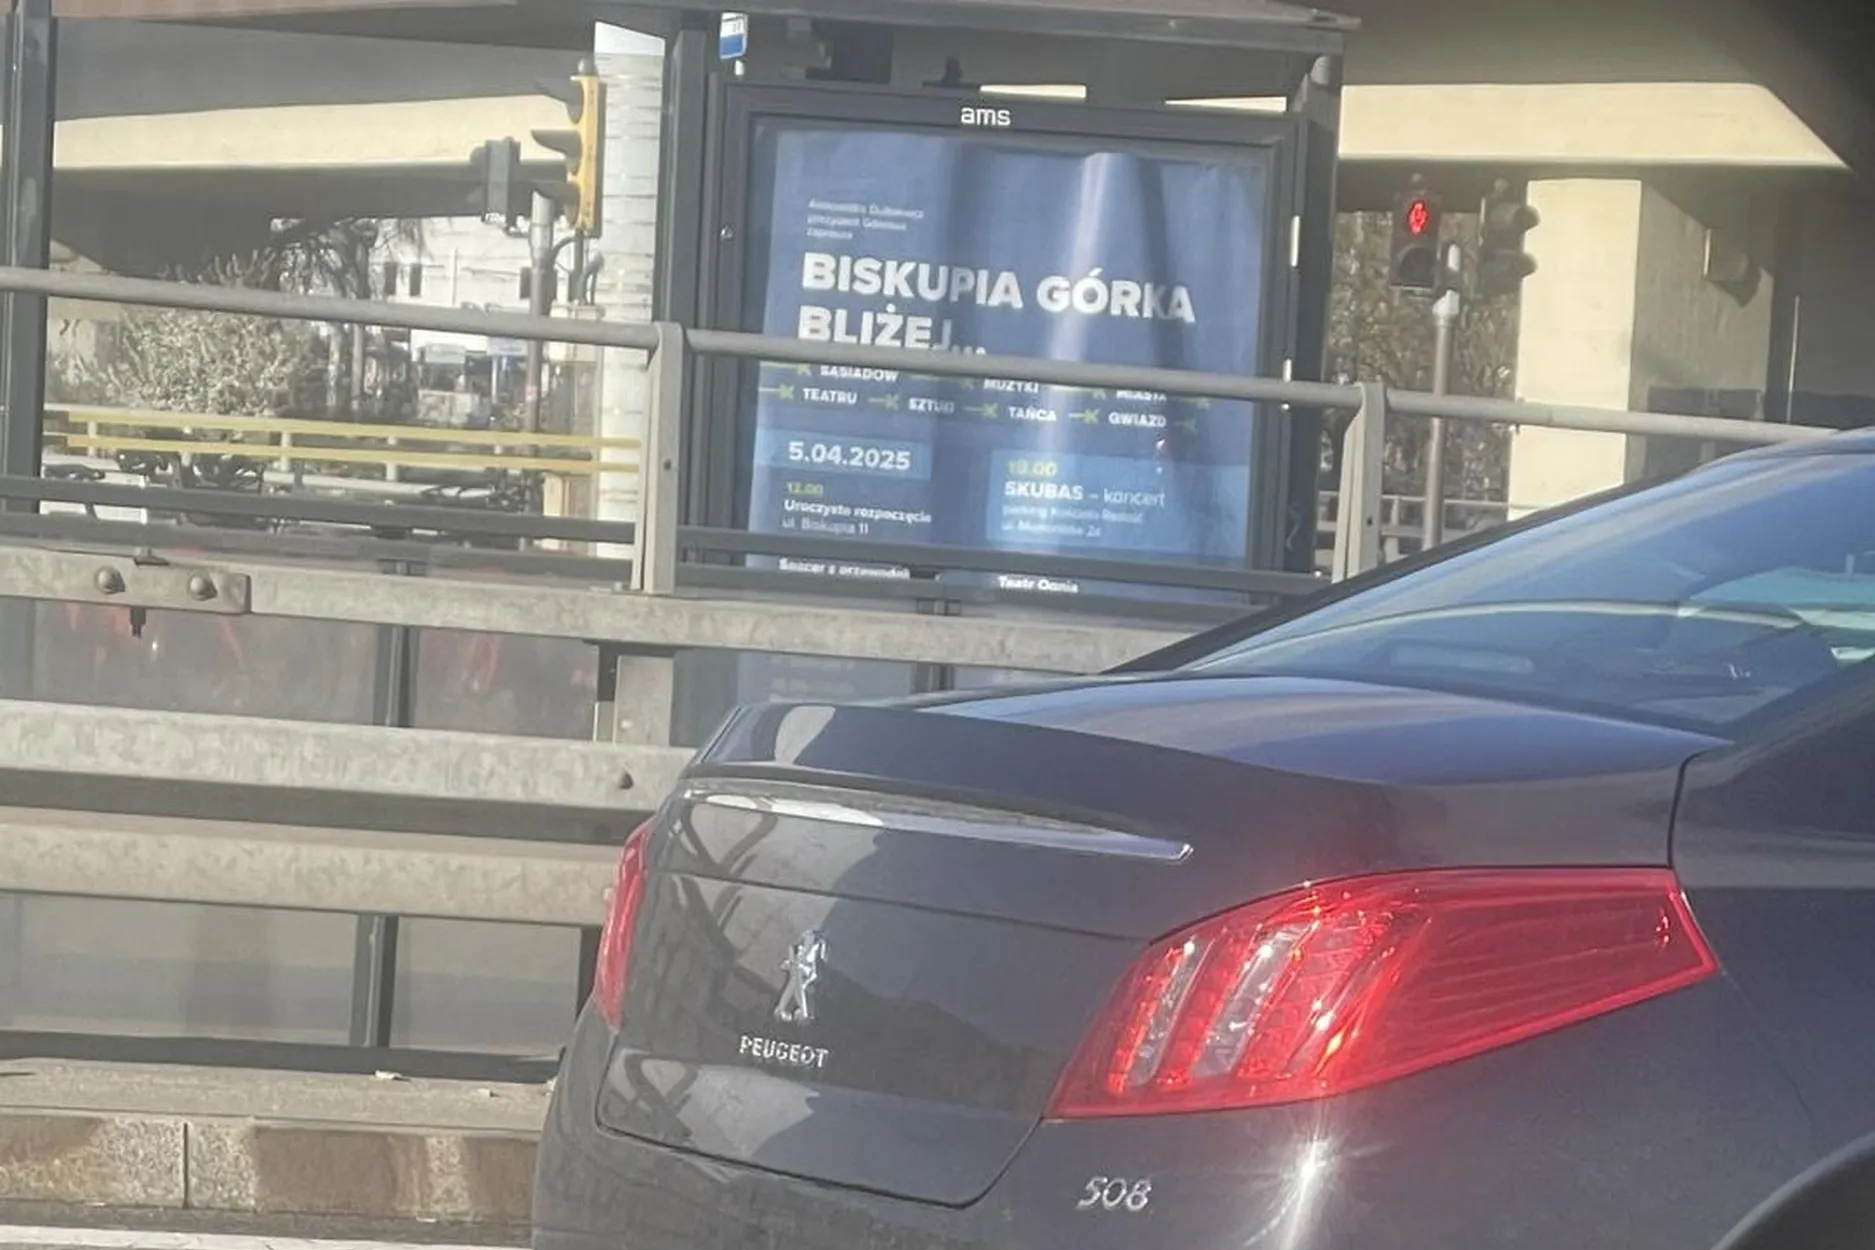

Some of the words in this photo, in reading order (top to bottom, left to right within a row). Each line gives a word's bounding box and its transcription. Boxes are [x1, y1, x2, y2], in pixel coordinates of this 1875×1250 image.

[961, 106, 1011, 126] ams
[802, 251, 1024, 309] BISKUPIA
[1036, 266, 1196, 324] GÓRKA
[802, 387, 859, 405] TEATRU
[1107, 410, 1168, 428] GWIAZD
[787, 440, 912, 471] 5.04.2025
[1003, 480, 1085, 501] SKUBAS
[1103, 487, 1166, 508] koncert
[739, 1035, 830, 1068] PEUGEOT
[1077, 1176, 1152, 1211] 508
